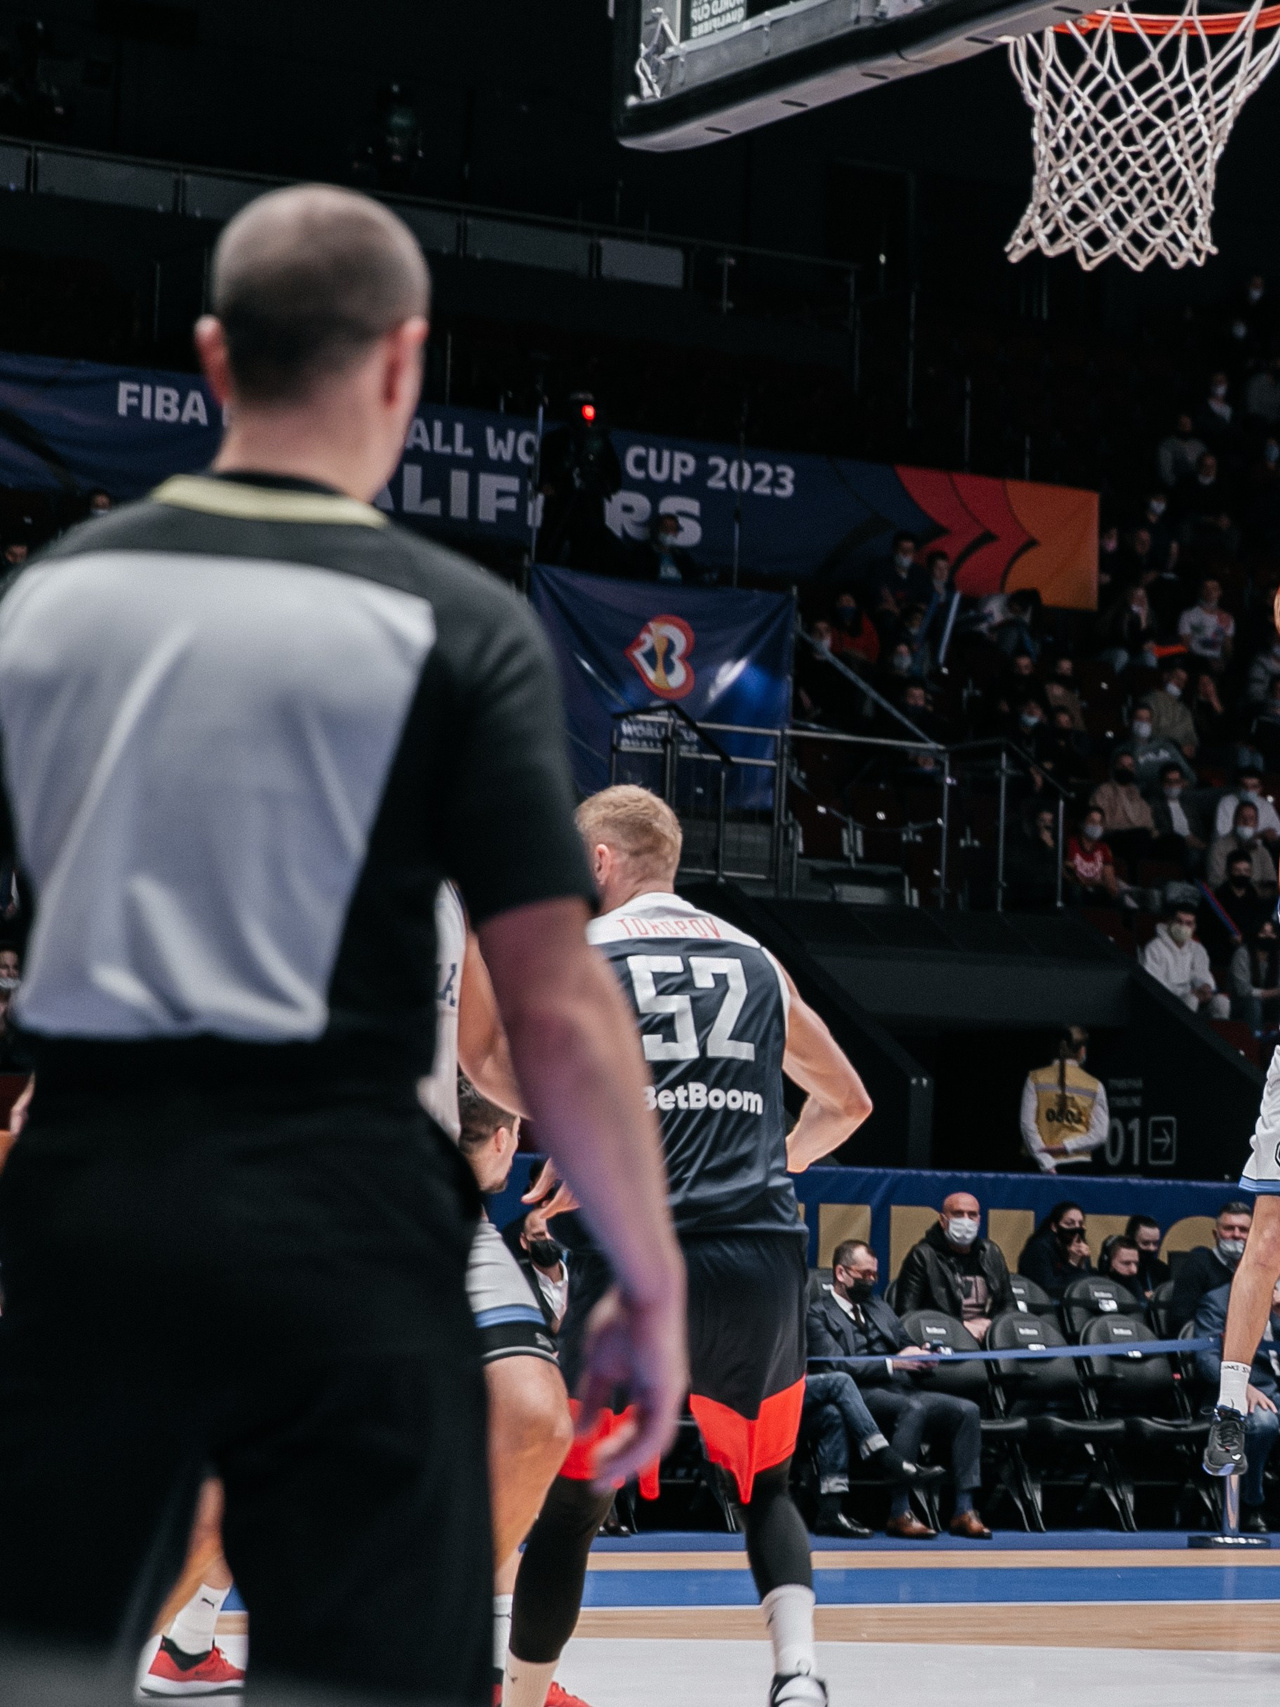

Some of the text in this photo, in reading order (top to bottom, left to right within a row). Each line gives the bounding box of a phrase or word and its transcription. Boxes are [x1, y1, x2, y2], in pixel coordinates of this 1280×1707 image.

[117, 380, 209, 427] FIBA
[625, 444, 796, 499] CUP 2023
[626, 954, 756, 1062] 52
[643, 1081, 764, 1116] BetBoom
